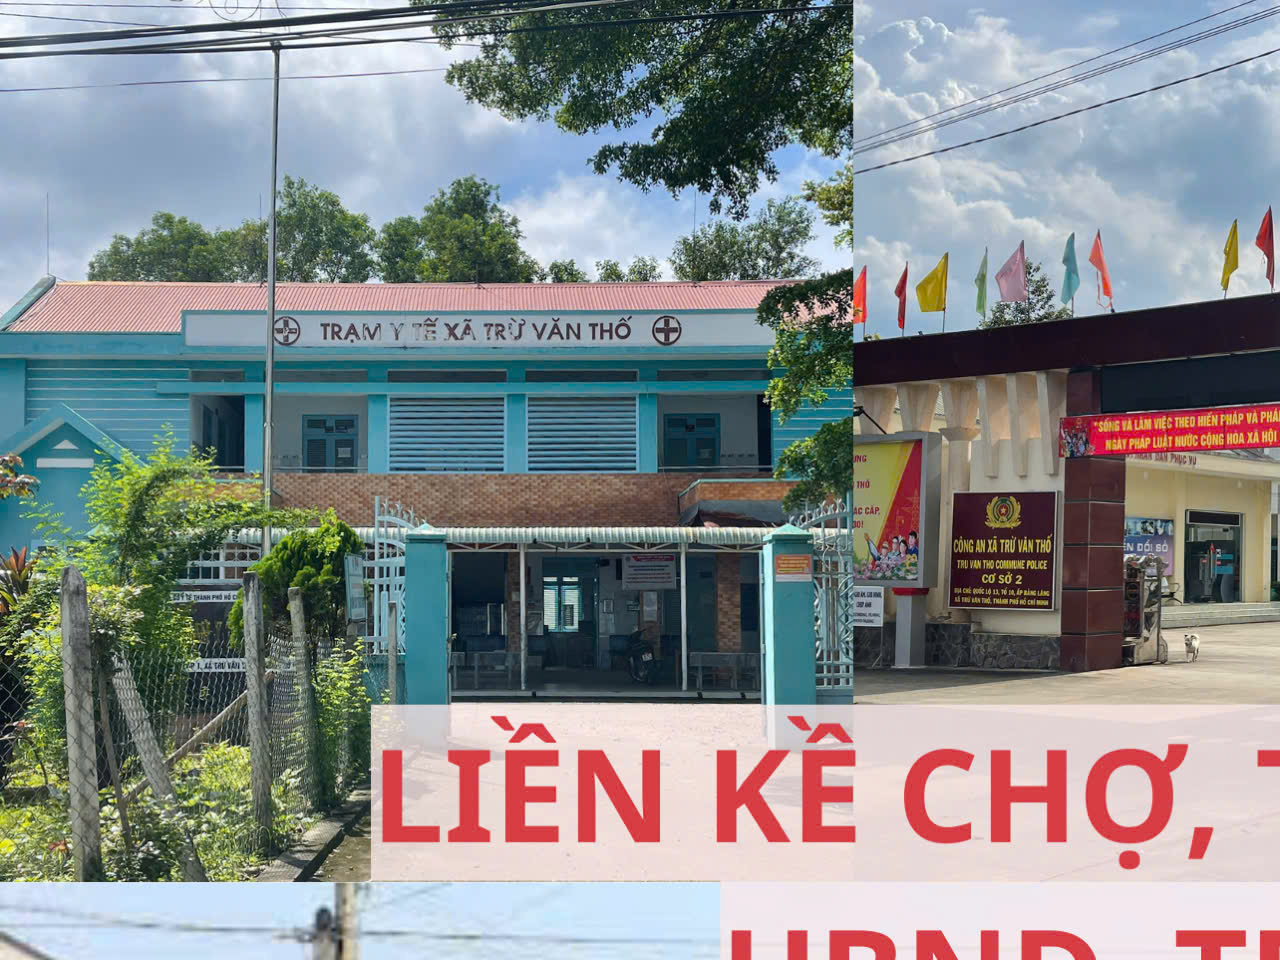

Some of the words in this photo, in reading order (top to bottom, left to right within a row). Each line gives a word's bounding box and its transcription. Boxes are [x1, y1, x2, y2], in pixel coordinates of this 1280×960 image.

[320, 322, 381, 343] TRẠM
[389, 323, 404, 341] Y
[412, 317, 439, 341] TẾ
[444, 318, 477, 341] XÃ
[484, 317, 526, 341] TRỪ
[532, 317, 581, 341] VĂN
[589, 315, 632, 340] THỐ
[1122, 419, 1133, 431] VÀ
[1154, 416, 1172, 430] VIỆC
[1174, 416, 1195, 428] THEO
[1221, 412, 1243, 425] PHÁP
[1246, 410, 1258, 424] VÀ
[1129, 436, 1150, 449] PHÁP
[1152, 435, 1173, 450] LUẬT
[1174, 433, 1198, 447] NƯỚC
[1200, 432, 1224, 449] CỘNG
[1247, 431, 1259, 443] XÃ
[1261, 428, 1277, 445] HỘI
[953, 535, 974, 553] CÔNG
[976, 539, 986, 553] AN
[988, 535, 998, 553] XÃ
[1000, 535, 1017, 553] TRỪ
[1018, 536, 1034, 553] VĂN
[1036, 533, 1053, 553] THỐ
[970, 560, 982, 569] VAN
[983, 560, 995, 569] THO
[996, 560, 1025, 569] COMMUNE
[1027, 560, 1048, 569] POLICE
[981, 573, 997, 584] CƠ
[998, 571, 1013, 584] SỞ
[1015, 574, 1023, 585] 2
